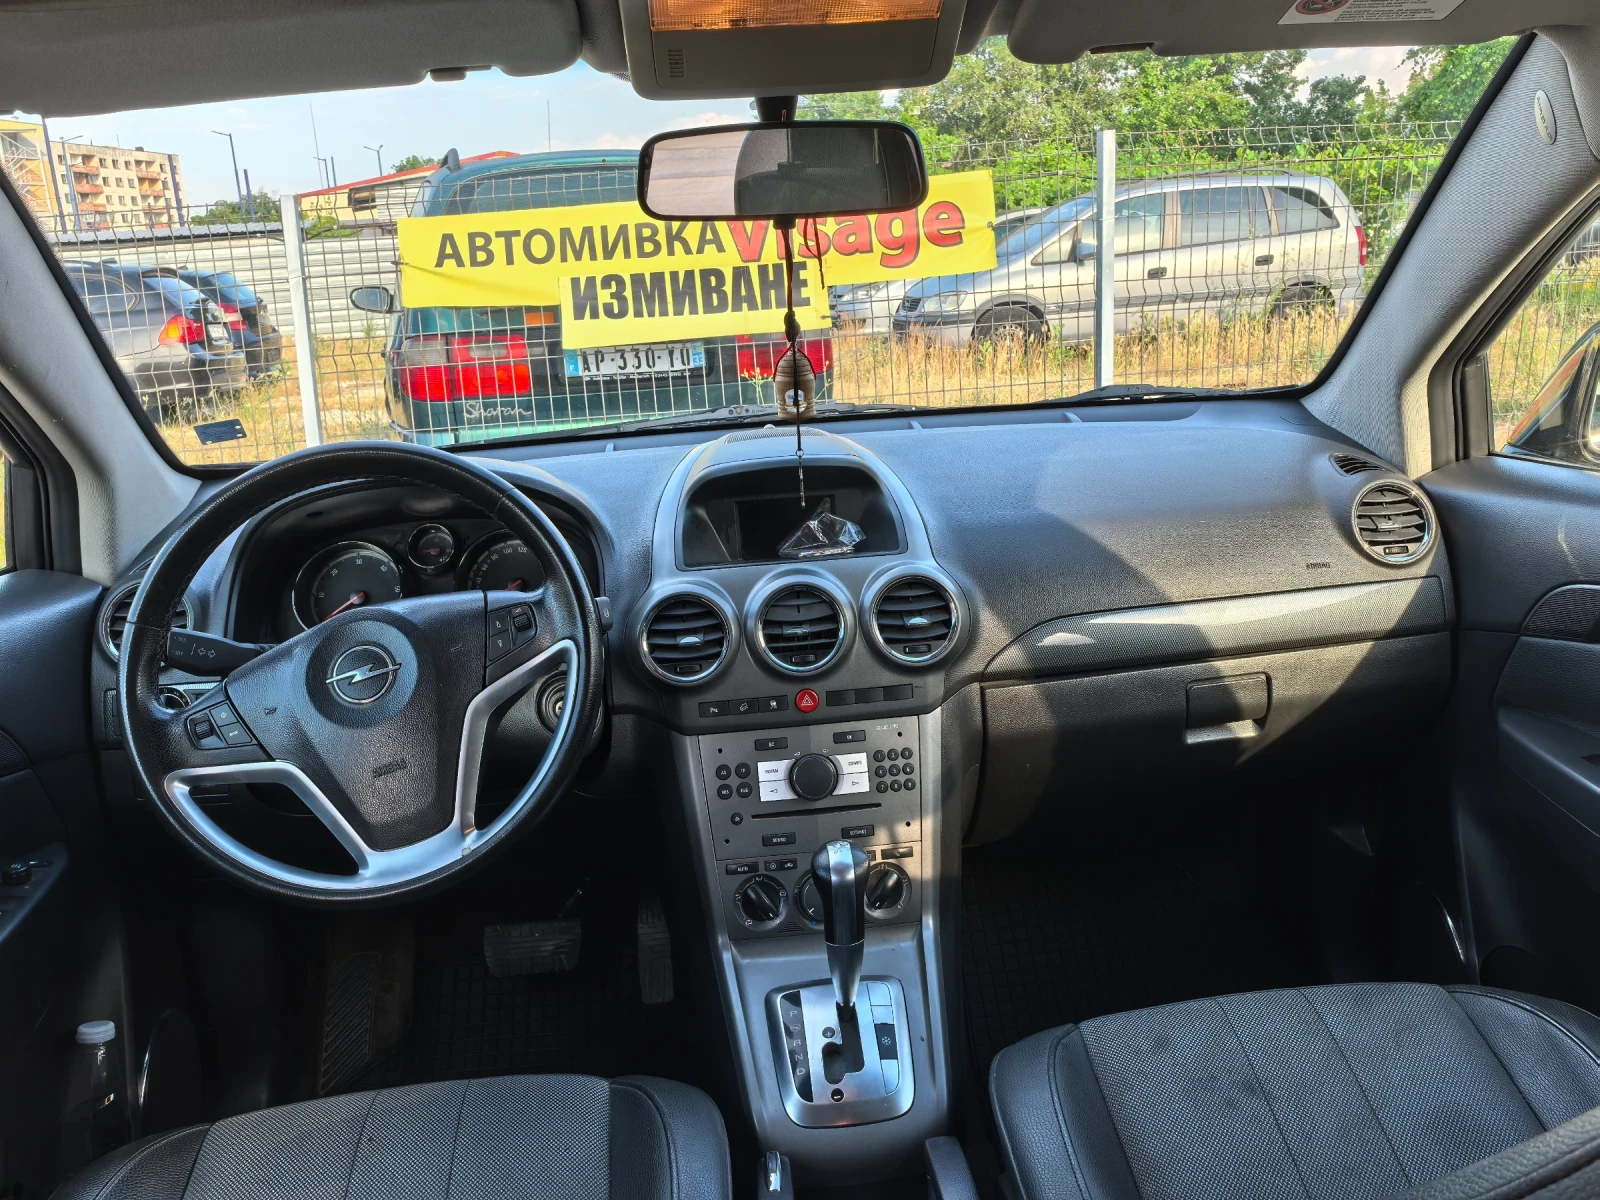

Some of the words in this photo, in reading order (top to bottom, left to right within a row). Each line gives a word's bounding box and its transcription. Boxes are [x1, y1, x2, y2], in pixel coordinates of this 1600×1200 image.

[434, 220, 726, 268] АВТОМИВКА
[570, 261, 811, 321] ИЗМИВАНЕ
[464, 402, 532, 418] Sharan
[797, 1068, 806, 1076] D
